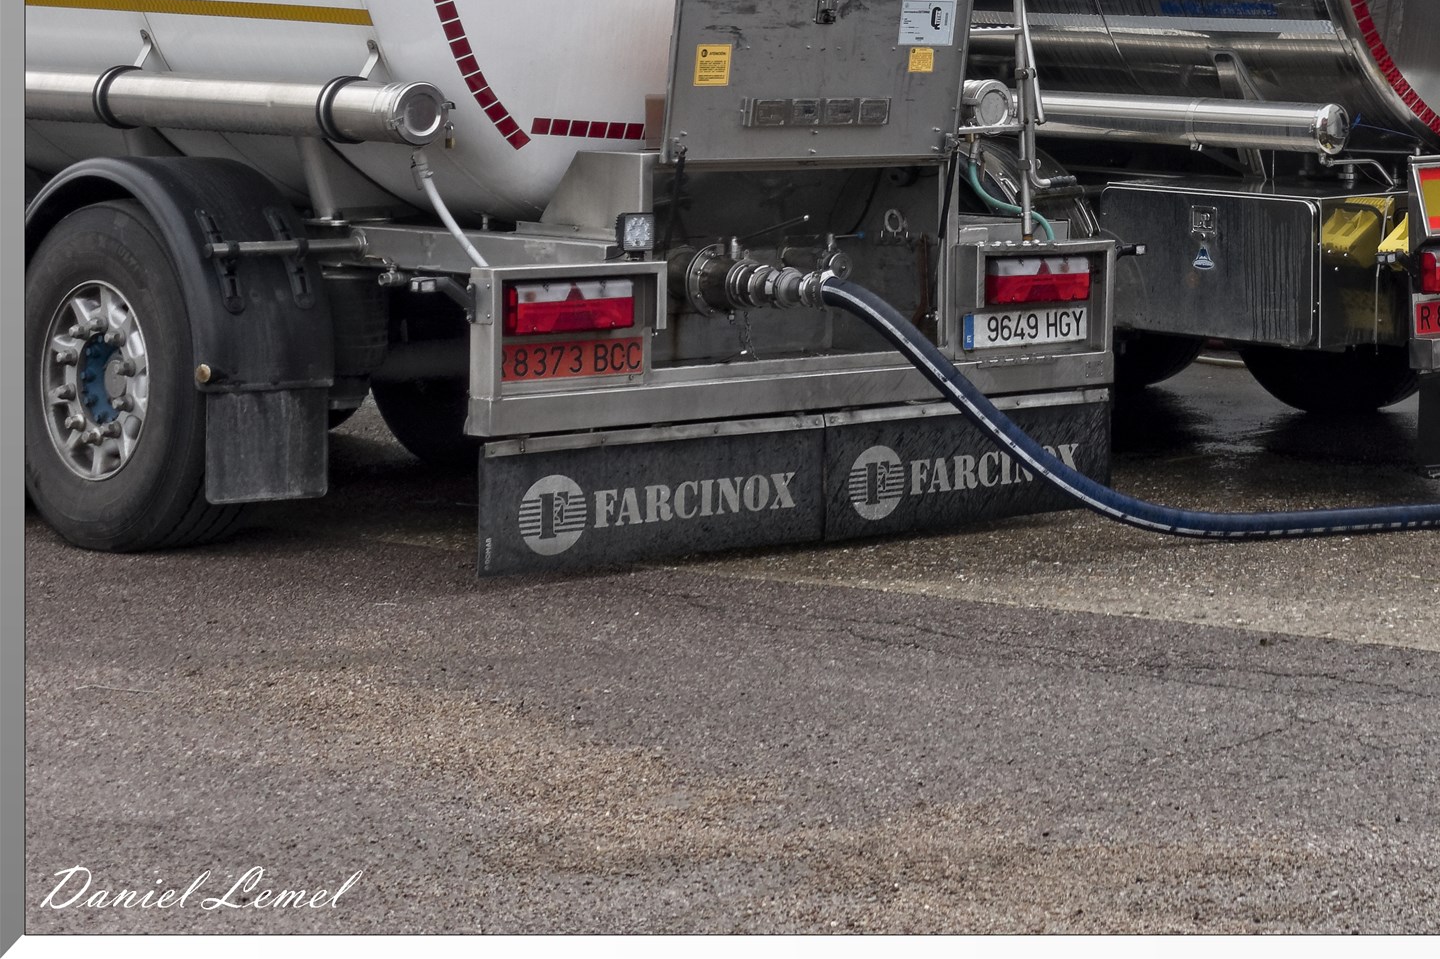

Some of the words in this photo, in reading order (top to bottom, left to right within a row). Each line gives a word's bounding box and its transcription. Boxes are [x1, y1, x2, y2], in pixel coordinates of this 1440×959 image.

[987, 313, 1039, 342] 9649
[1046, 310, 1084, 338] HGY
[1421, 306, 1431, 330] R
[594, 342, 641, 372] BCC
[909, 443, 1079, 496] FARCIX
[593, 471, 797, 529] FARCINOX
